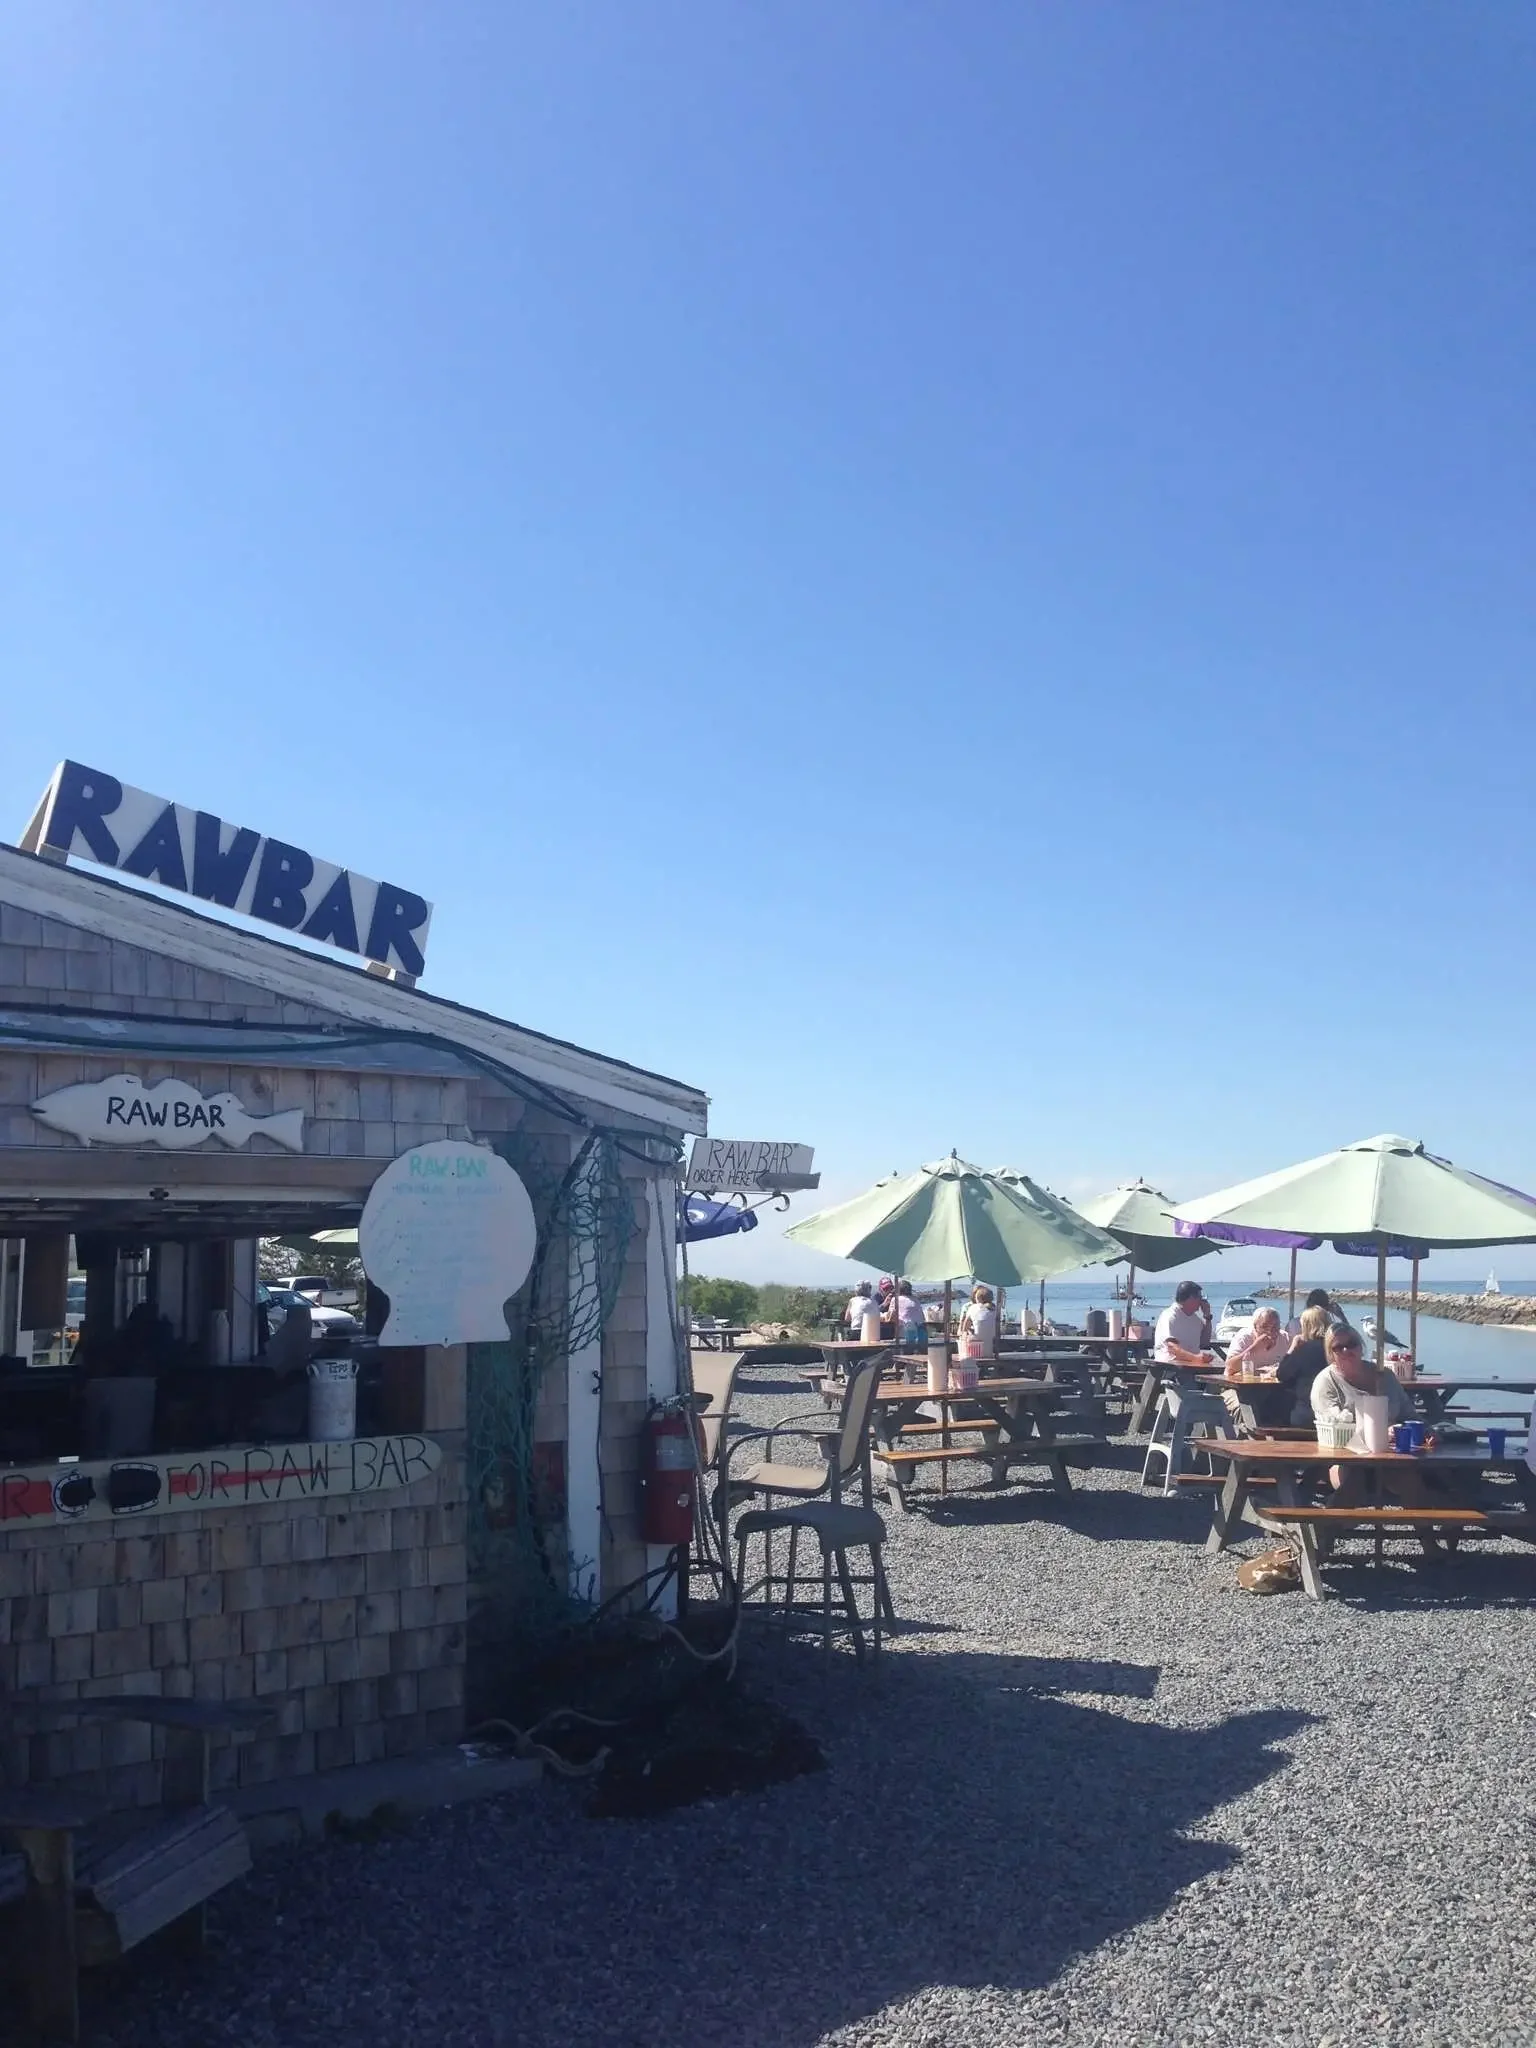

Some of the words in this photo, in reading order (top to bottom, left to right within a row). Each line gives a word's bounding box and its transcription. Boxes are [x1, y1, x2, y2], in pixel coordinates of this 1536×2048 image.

[106, 1097, 169, 1127] RAW
[174, 1101, 225, 1128] BAR
[410, 1154, 450, 1178] RAW
[456, 1156, 488, 1179] BAR
[707, 1140, 754, 1169] RAW
[756, 1141, 793, 1176] BAR
[693, 1169, 724, 1184] ORDER
[168, 1459, 230, 1504] FOR
[244, 1443, 330, 1500] RAW
[349, 1434, 433, 1492] BAR
